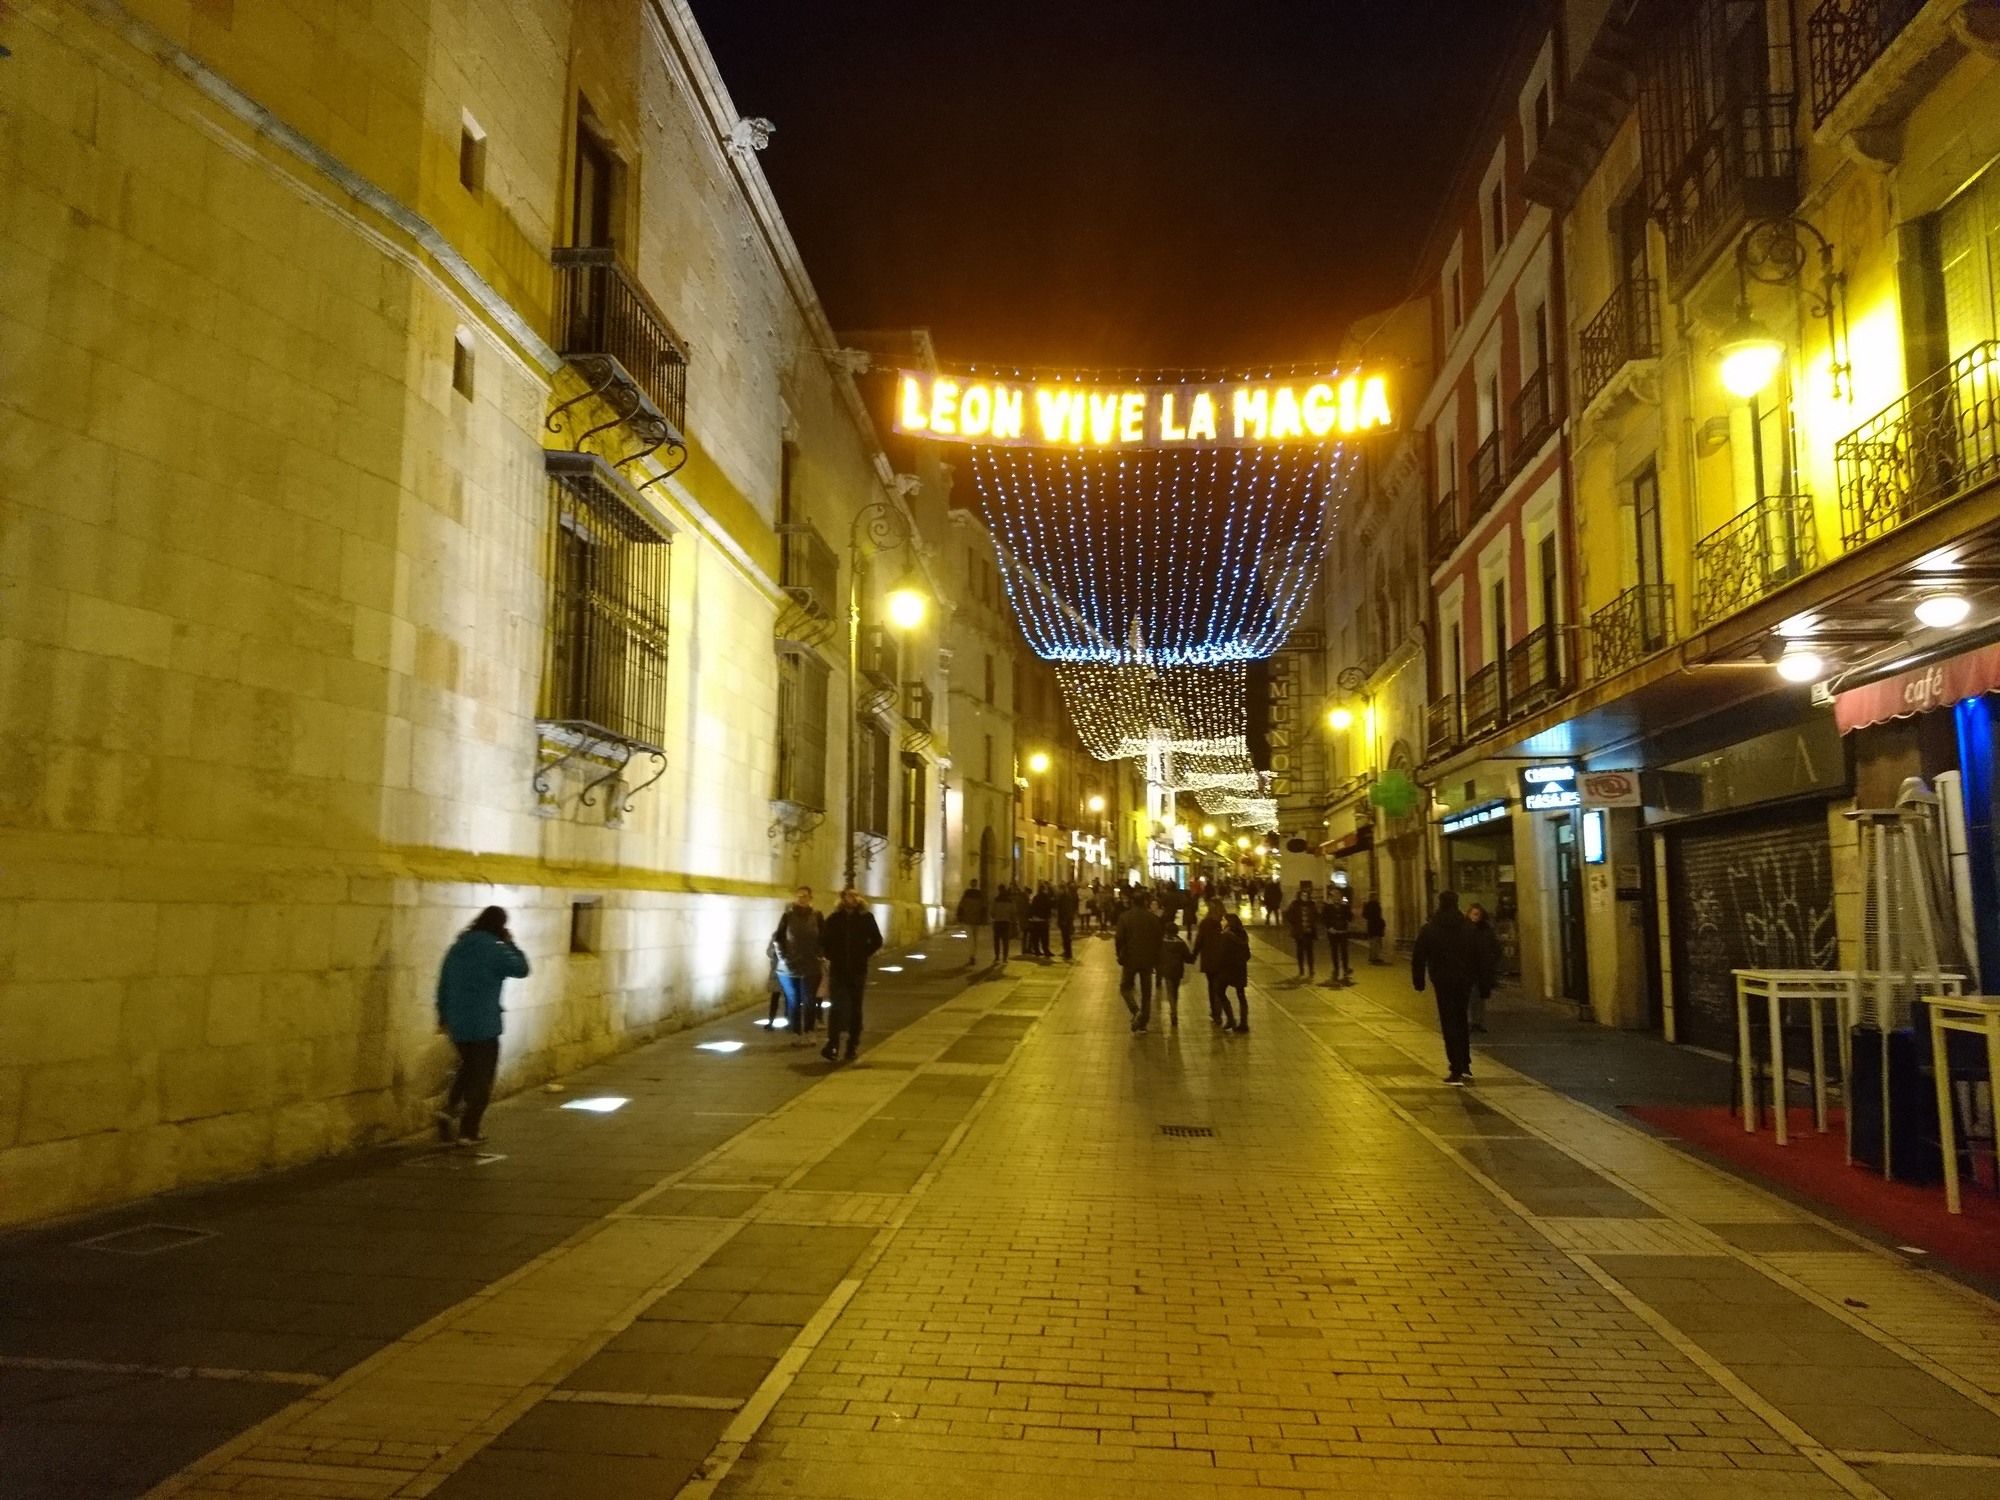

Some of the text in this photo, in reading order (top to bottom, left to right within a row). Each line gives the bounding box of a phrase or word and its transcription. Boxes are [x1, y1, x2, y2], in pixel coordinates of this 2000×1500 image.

[901, 376, 1023, 439] LEON
[1036, 388, 1146, 444] VIVE
[1160, 392, 1217, 440] LA
[1903, 666, 1943, 708] café
